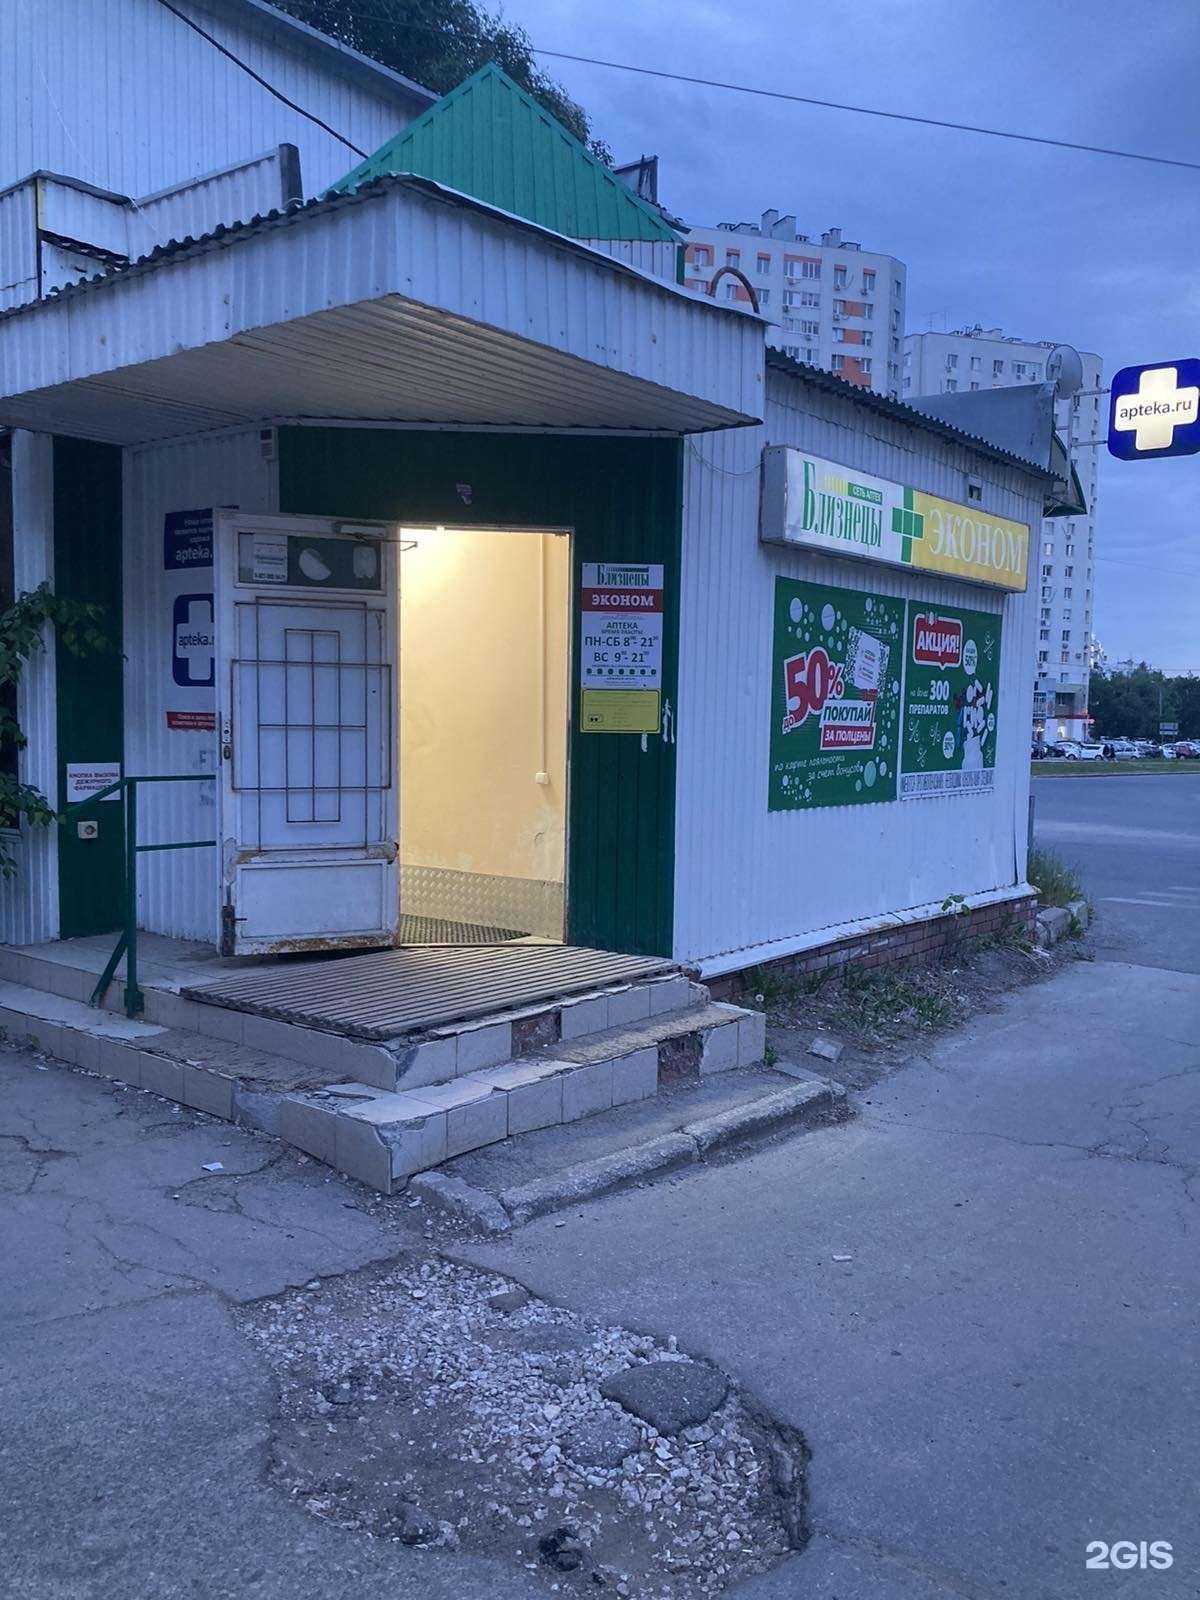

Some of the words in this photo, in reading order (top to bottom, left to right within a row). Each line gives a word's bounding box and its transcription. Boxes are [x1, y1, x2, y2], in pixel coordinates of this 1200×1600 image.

[1120, 400, 1192, 420] apteka.ru
[801, 460, 882, 549] Близнецы
[928, 507, 1024, 575] ЭКОНОМ
[597, 564, 650, 586] Близнецы
[606, 621, 639, 630] АПТЕКА
[584, 636, 620, 647] ПН-СБ
[916, 630, 960, 656] АКЦИЯ!
[594, 652, 609, 662] ВС
[786, 649, 844, 722] 50%
[929, 680, 950, 700] 300
[823, 702, 871, 721] ПОКУПАЙ
[908, 704, 949, 715] ПРЕПАРАТОВ
[824, 730, 834, 741] ЗА
[835, 730, 871, 744] ПОЛЦЕНЫ
